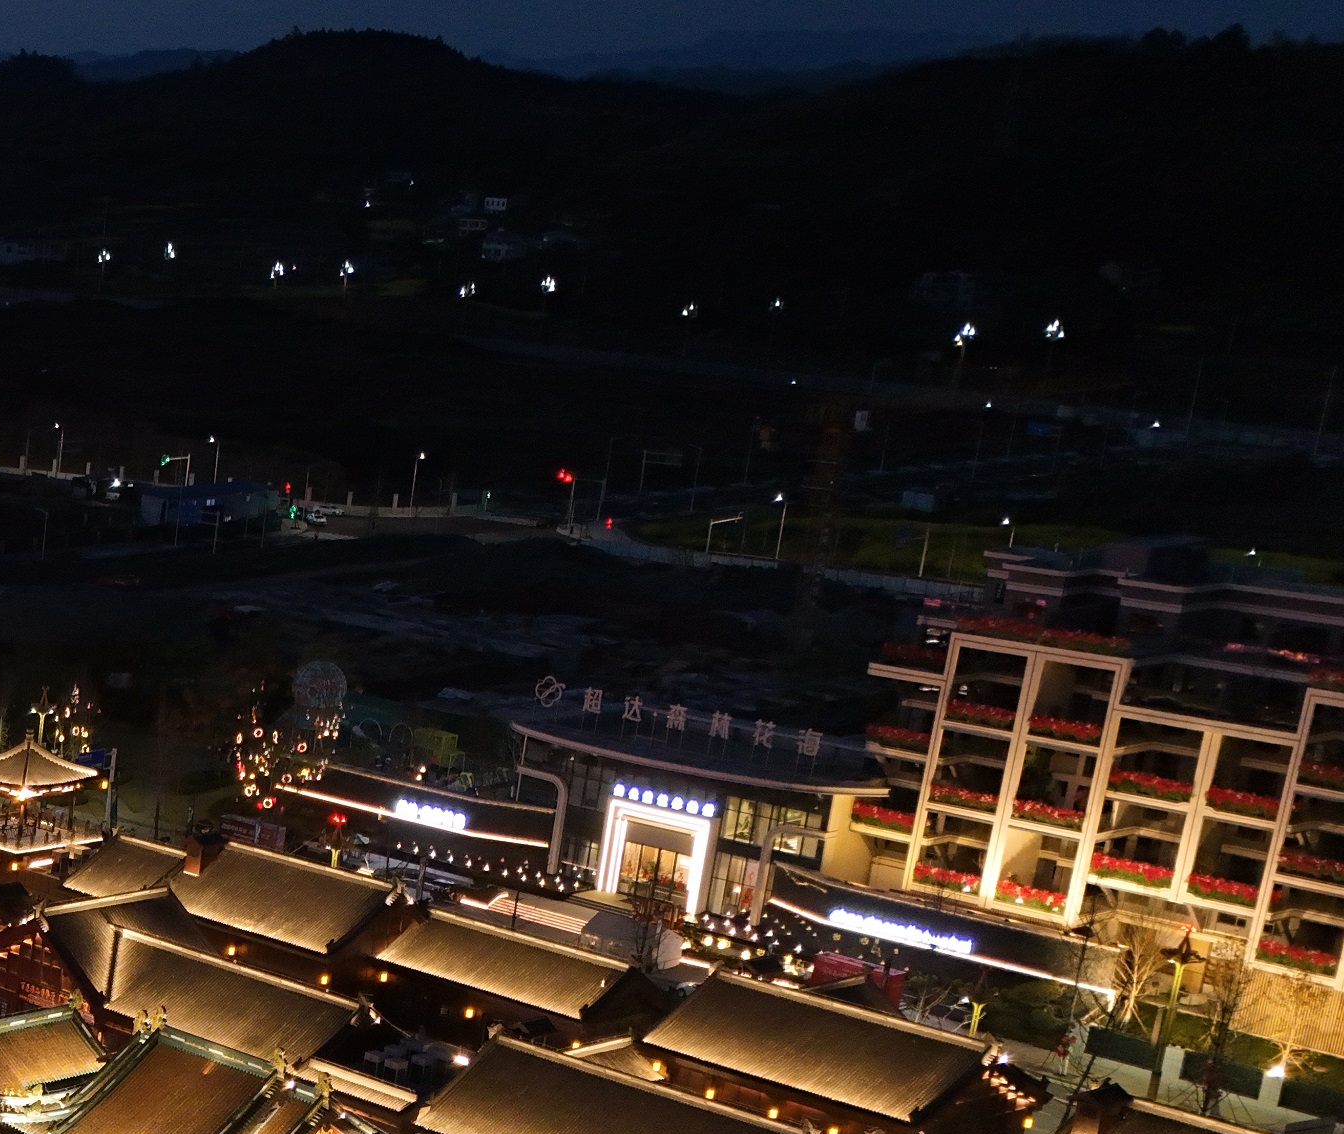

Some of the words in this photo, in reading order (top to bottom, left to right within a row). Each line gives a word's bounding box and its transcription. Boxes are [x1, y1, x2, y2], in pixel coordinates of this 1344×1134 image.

[582, 686, 823, 757] 超达森林花海
